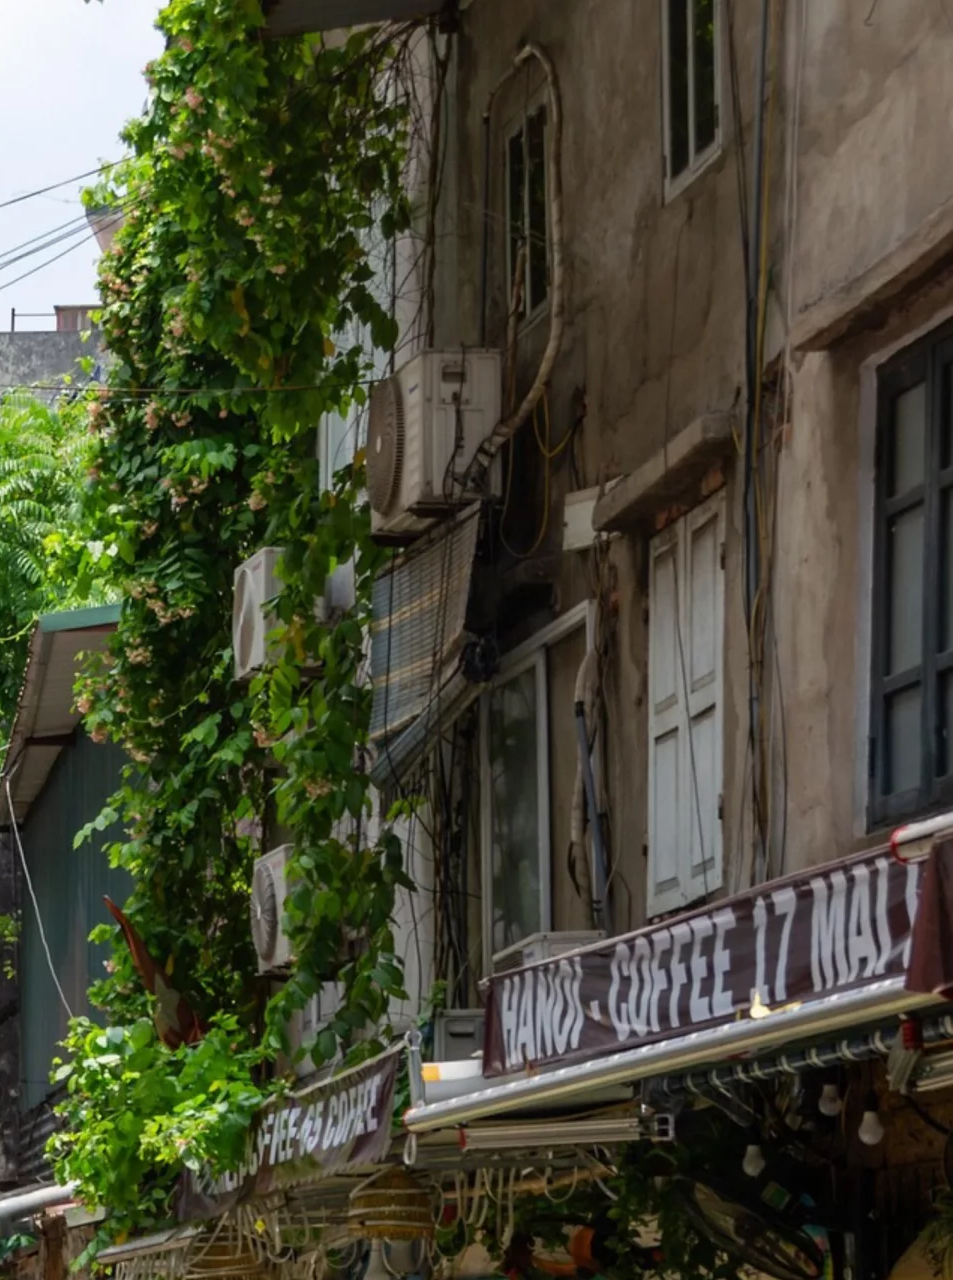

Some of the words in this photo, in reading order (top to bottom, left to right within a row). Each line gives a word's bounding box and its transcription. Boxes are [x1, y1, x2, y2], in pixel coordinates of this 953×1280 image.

[500, 955, 586, 1069] HANOI
[608, 907, 735, 1042] COFFEE
[752, 886, 797, 1003] 17
